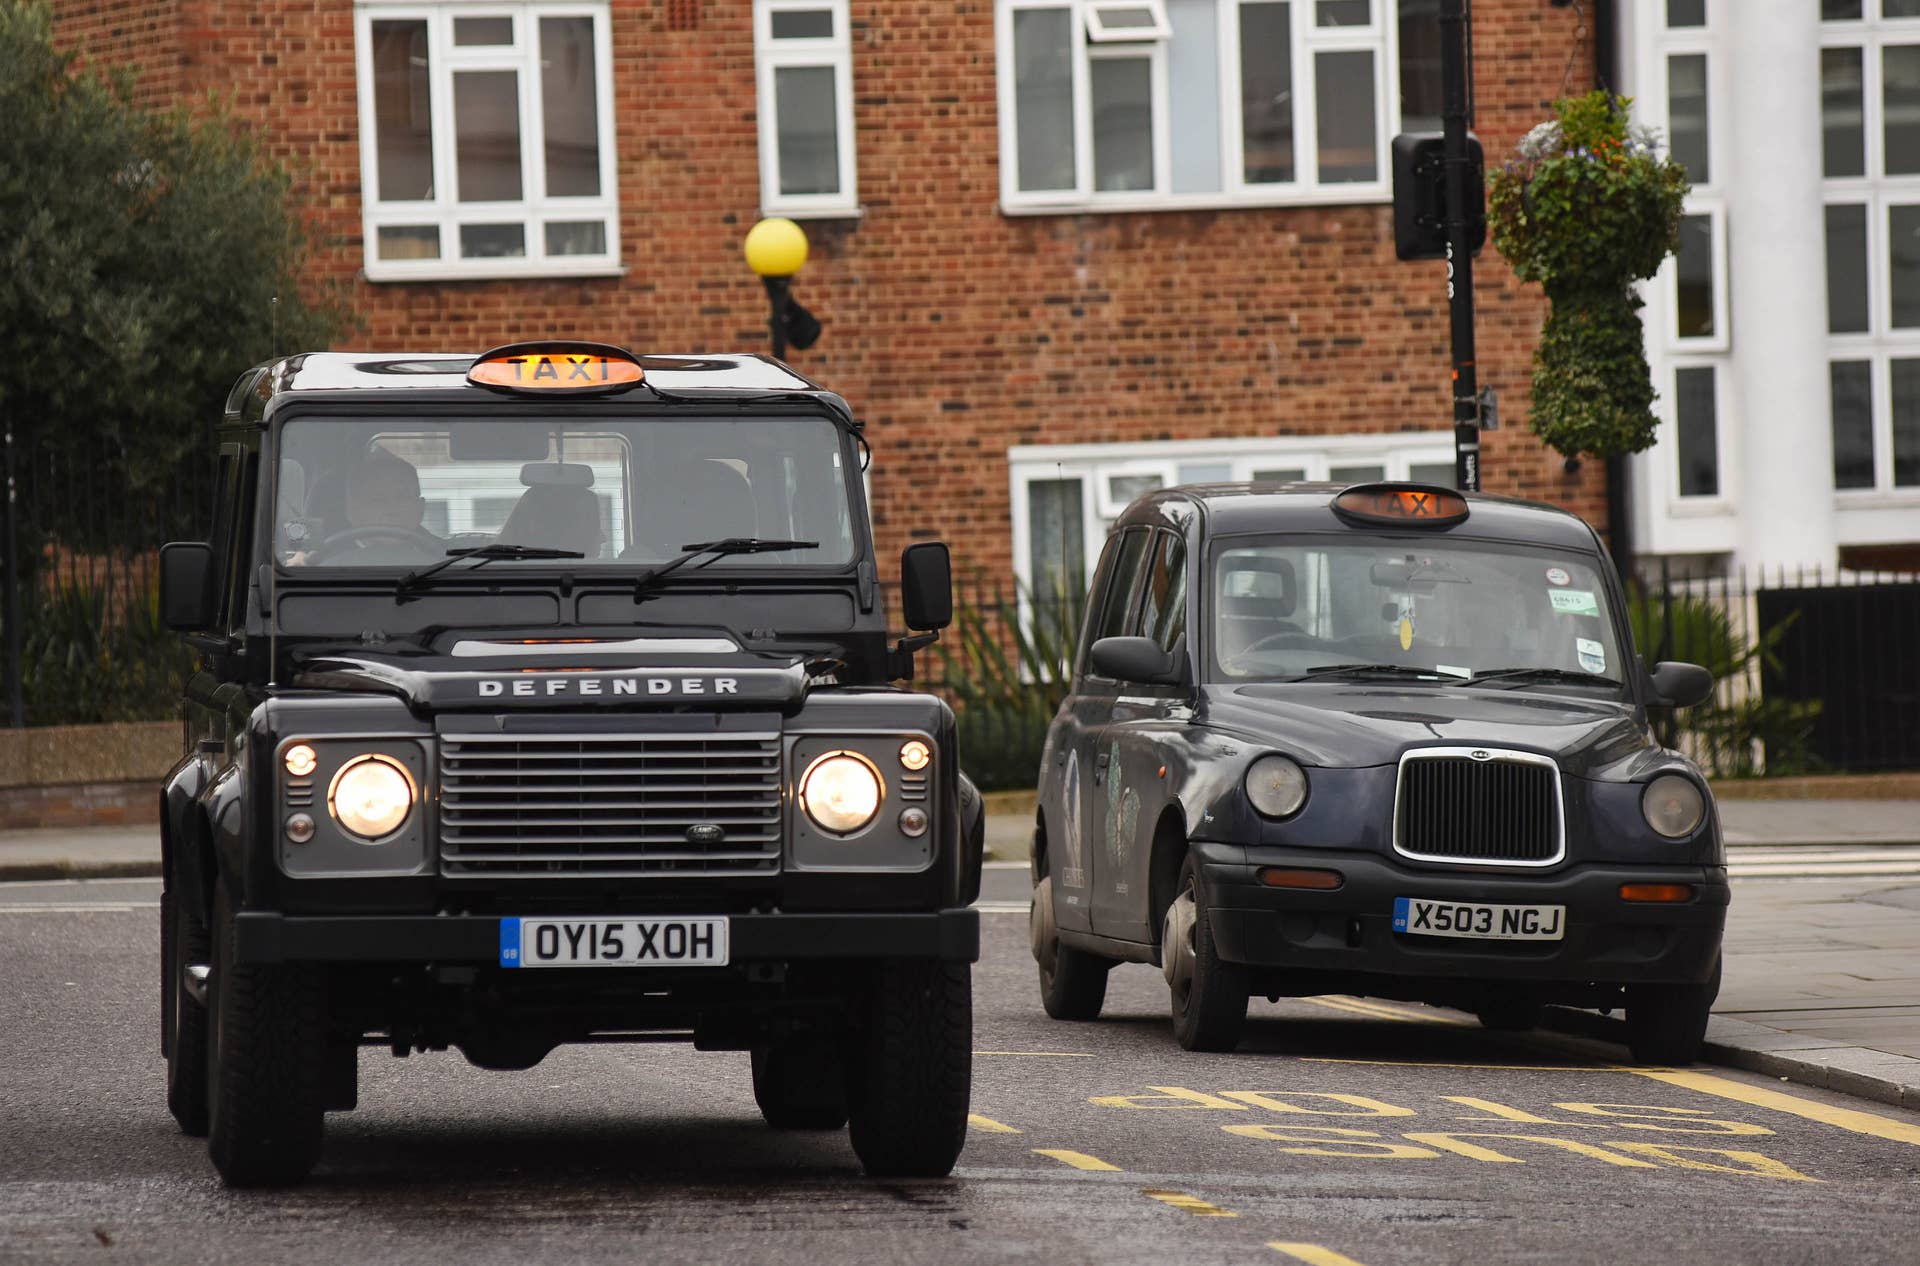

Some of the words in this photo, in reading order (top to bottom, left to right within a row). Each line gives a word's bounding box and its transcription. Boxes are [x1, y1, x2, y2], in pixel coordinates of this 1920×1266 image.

[506, 357, 609, 382] TAXI
[1371, 493, 1442, 515] TAXI
[478, 678, 738, 696] DEFENDER
[1413, 902, 1493, 933] X503
[1501, 908, 1559, 935] NGJ
[503, 948, 517, 959] GB
[536, 923, 624, 960] OY15
[637, 923, 713, 959] XOH
[1088, 1085, 1777, 1136] STOP
[1219, 1123, 1830, 1183] BUS
